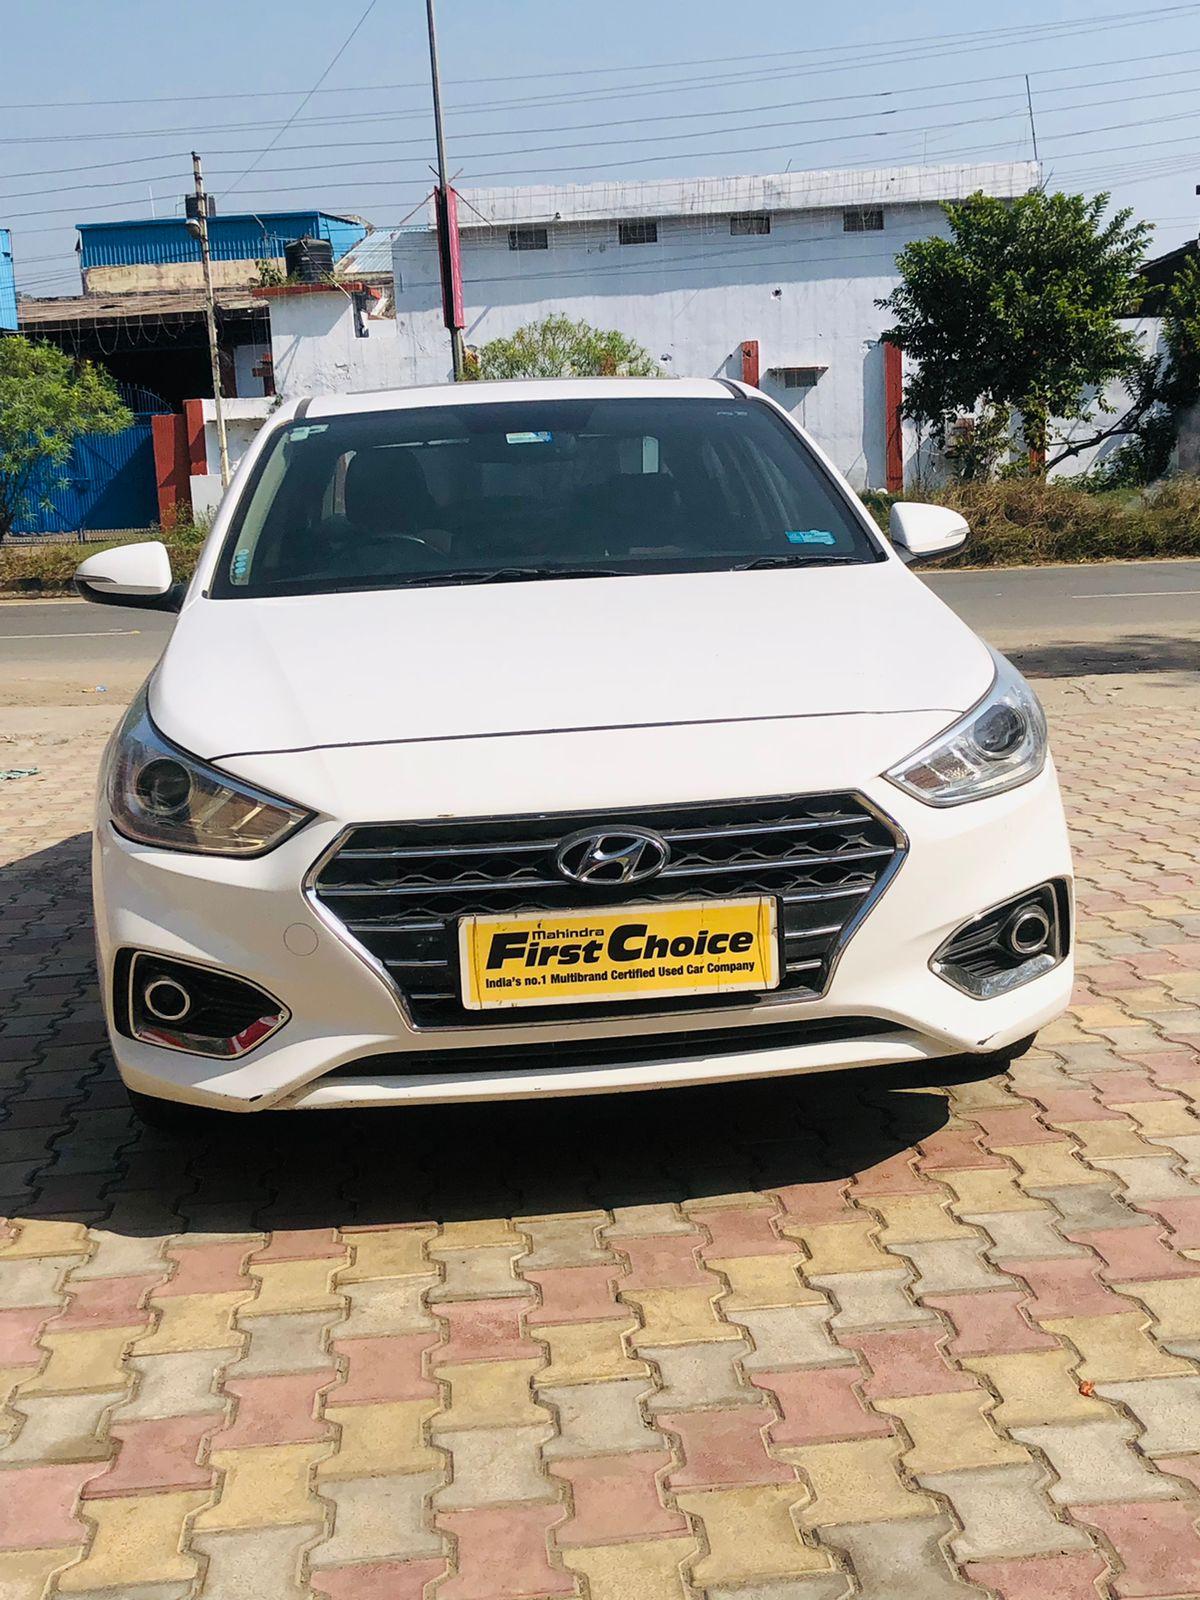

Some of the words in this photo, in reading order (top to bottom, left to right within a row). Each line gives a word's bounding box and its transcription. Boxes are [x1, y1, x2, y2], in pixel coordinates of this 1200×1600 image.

[485, 931, 604, 970] First
[607, 923, 754, 962] Choice
[532, 927, 605, 940] Mahindra
[485, 976, 522, 988] India's
[524, 974, 546, 986] no.1
[550, 970, 608, 984] Multibrand
[611, 967, 655, 980] Certified
[658, 965, 684, 976] Used
[686, 963, 705, 974] Car
[707, 961, 755, 974] Company
